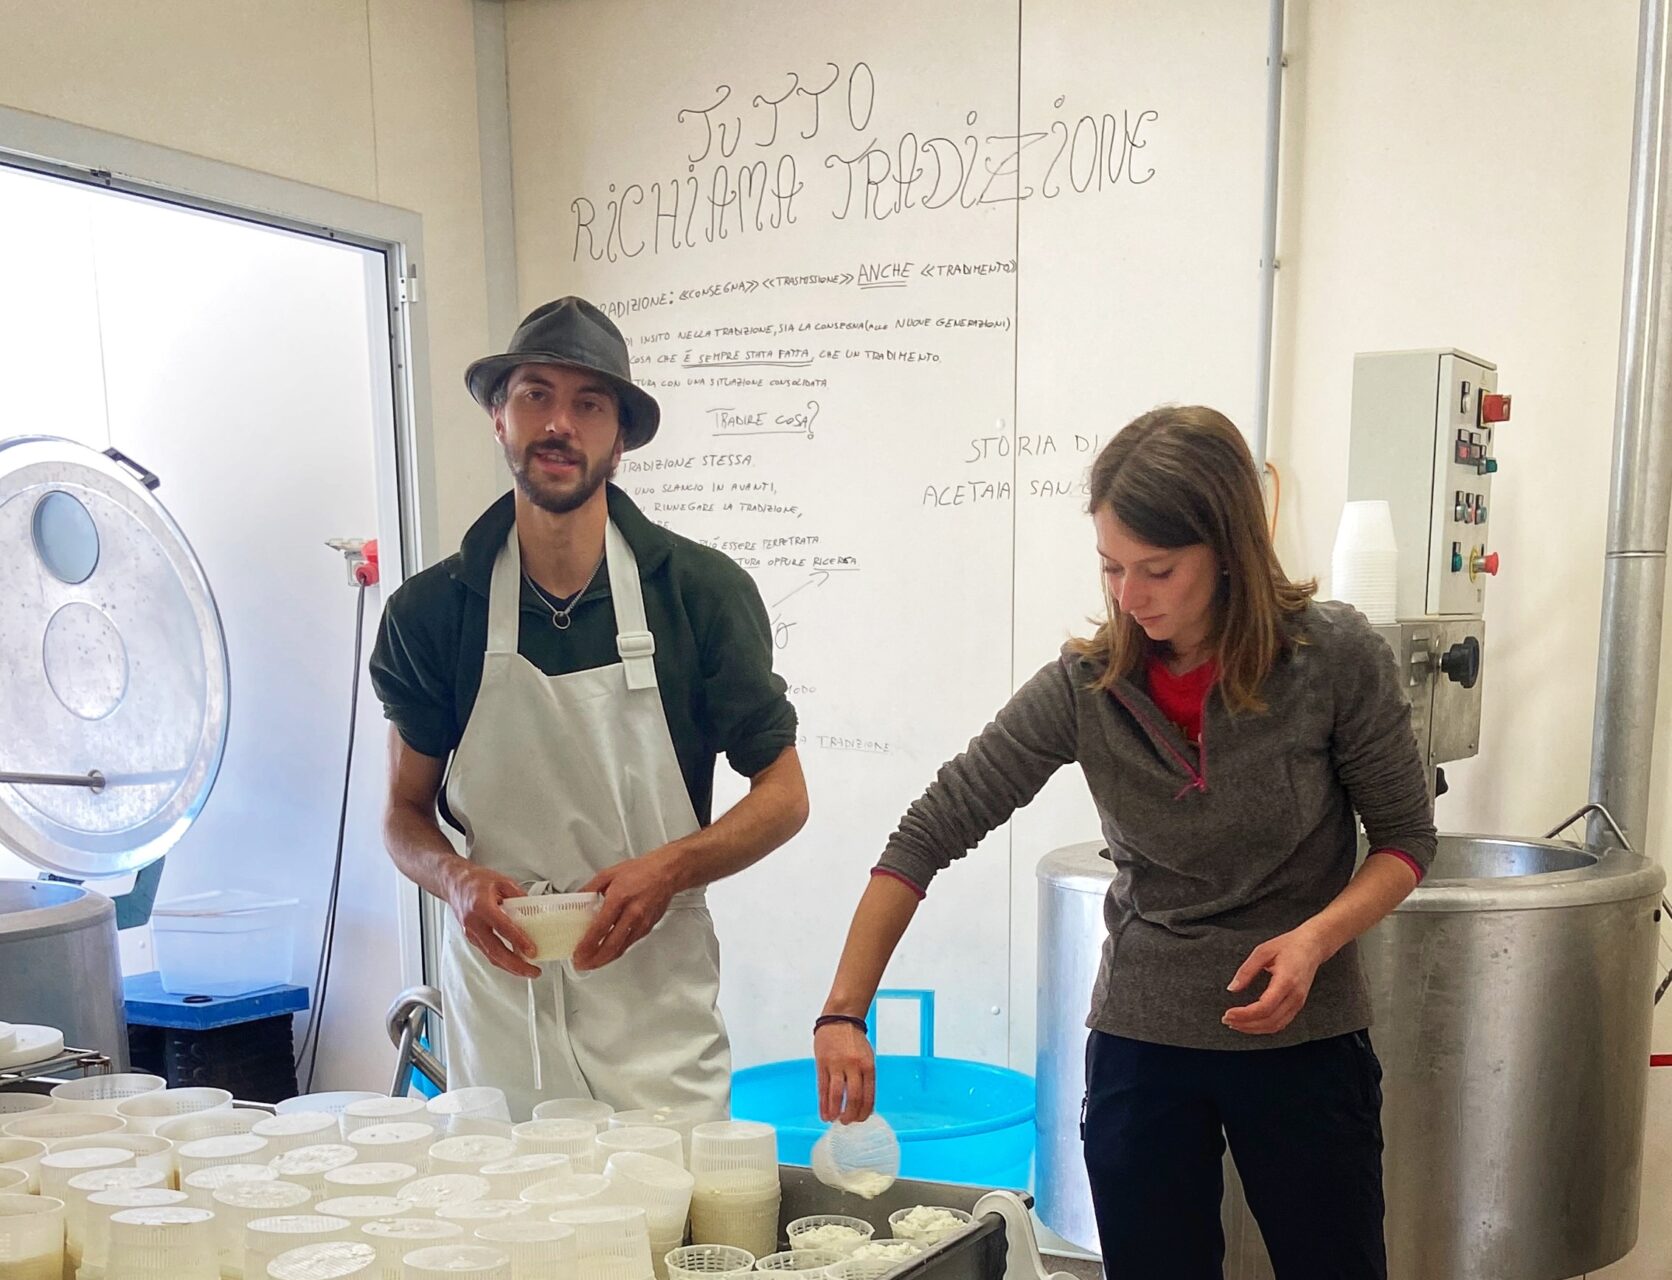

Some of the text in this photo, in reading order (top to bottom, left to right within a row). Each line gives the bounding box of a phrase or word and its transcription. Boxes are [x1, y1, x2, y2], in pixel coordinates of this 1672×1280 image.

[824, 94, 1159, 221] TRADIZIONE
[598, 290, 674, 319] RADIZIONE:
[858, 262, 915, 285] ANCHE
[640, 331, 671, 345] INSITO
[778, 320, 796, 333] SIA
[798, 322, 812, 332] LA
[895, 317, 931, 329] NUOVE
[657, 353, 678, 364] CHE
[698, 350, 741, 364] SEMPRE
[745, 349, 774, 361] STATA
[818, 350, 841, 360] CHE
[845, 350, 861, 359] UN
[661, 379, 682, 388] CON
[687, 378, 705, 387] UNA
[710, 376, 765, 388] SITUAZIONE
[706, 400, 820, 441] TRADIRE COSA?
[965, 434, 1057, 464] STORIA
[620, 457, 696, 473] TRADIZIONE
[634, 487, 656, 496] UNO
[661, 482, 705, 494] SLANCIO
[712, 483, 725, 492] IN
[922, 480, 1012, 508] ACETAIA
[654, 501, 715, 512] RINNEGARE
[723, 502, 734, 511] LA
[721, 541, 757, 551] ESSERE
[767, 556, 807, 567] OPPURE
